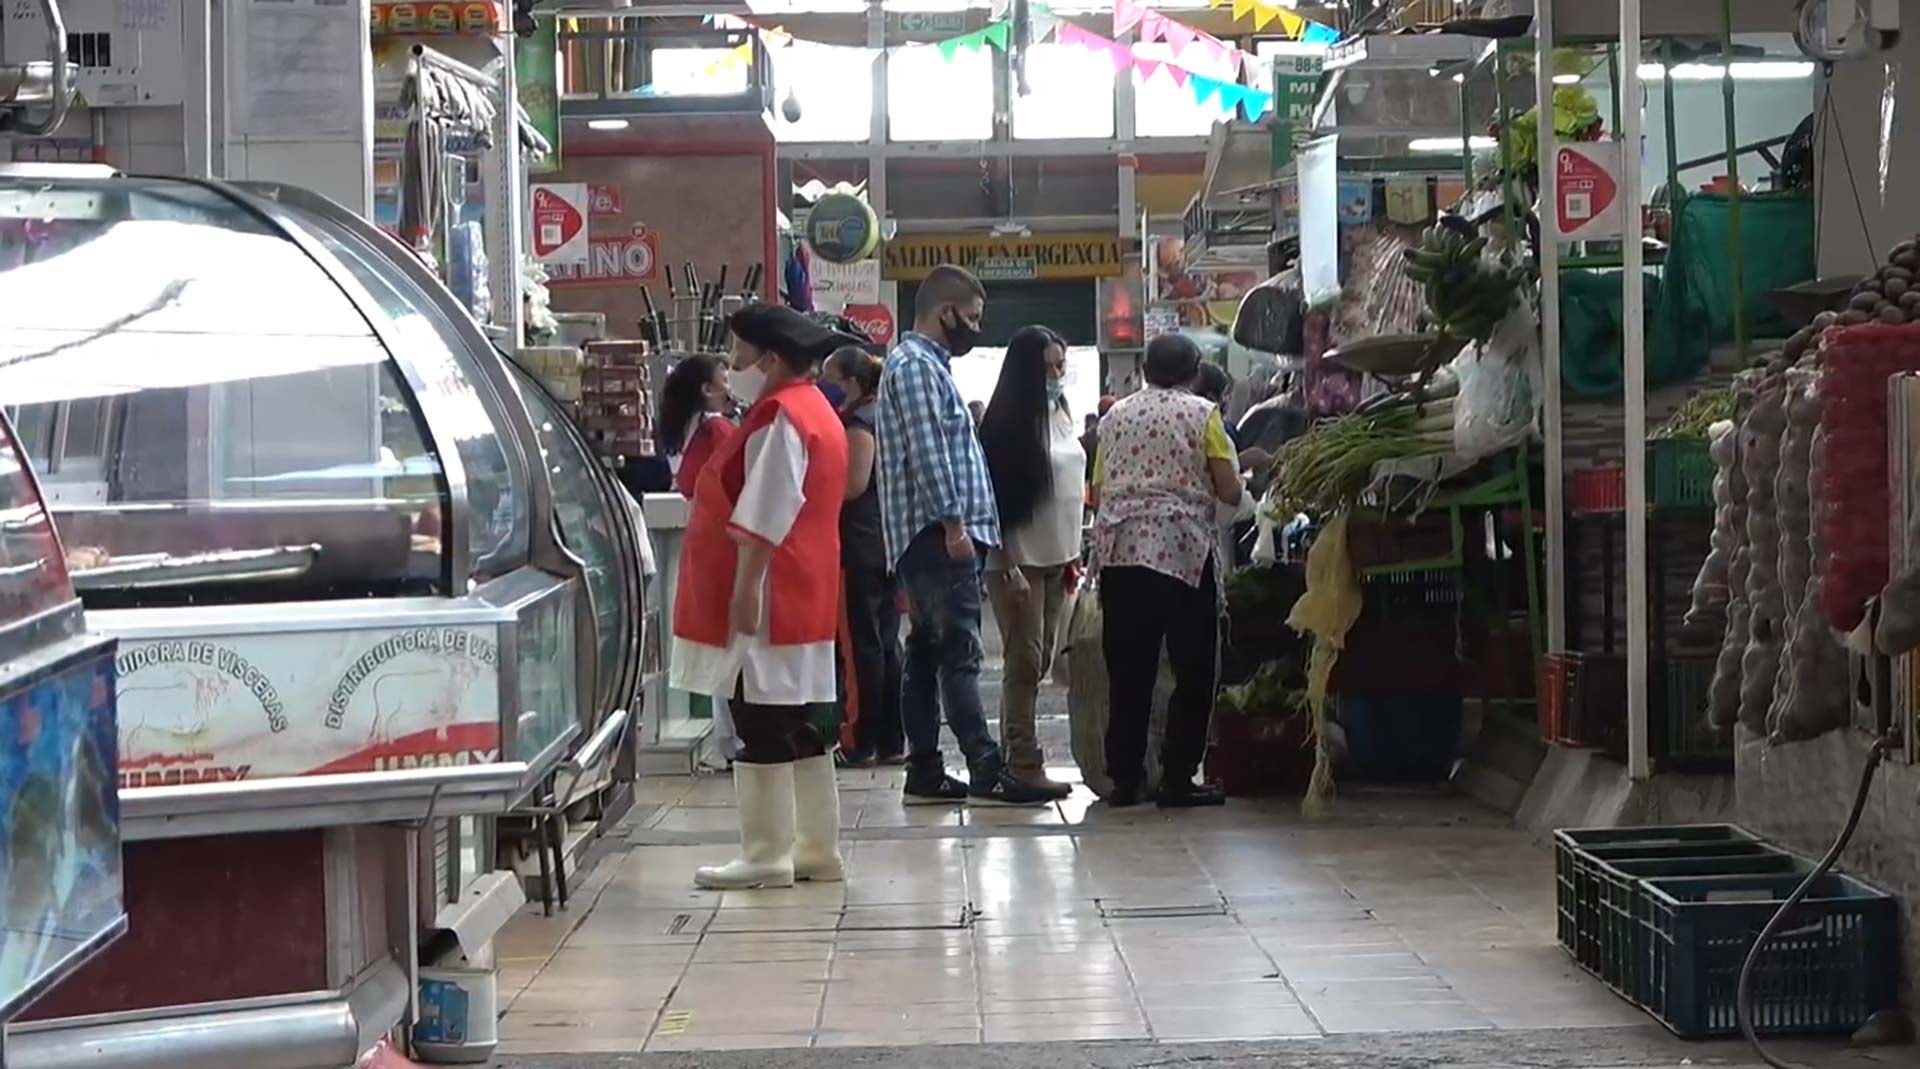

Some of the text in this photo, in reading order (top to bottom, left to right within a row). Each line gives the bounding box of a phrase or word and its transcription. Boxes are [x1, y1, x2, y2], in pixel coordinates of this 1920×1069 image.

[188, 641, 215, 665] DE
[217, 647, 288, 733] VISCERAS
[325, 628, 499, 730] DISTRIBUIDORA DE VIS
